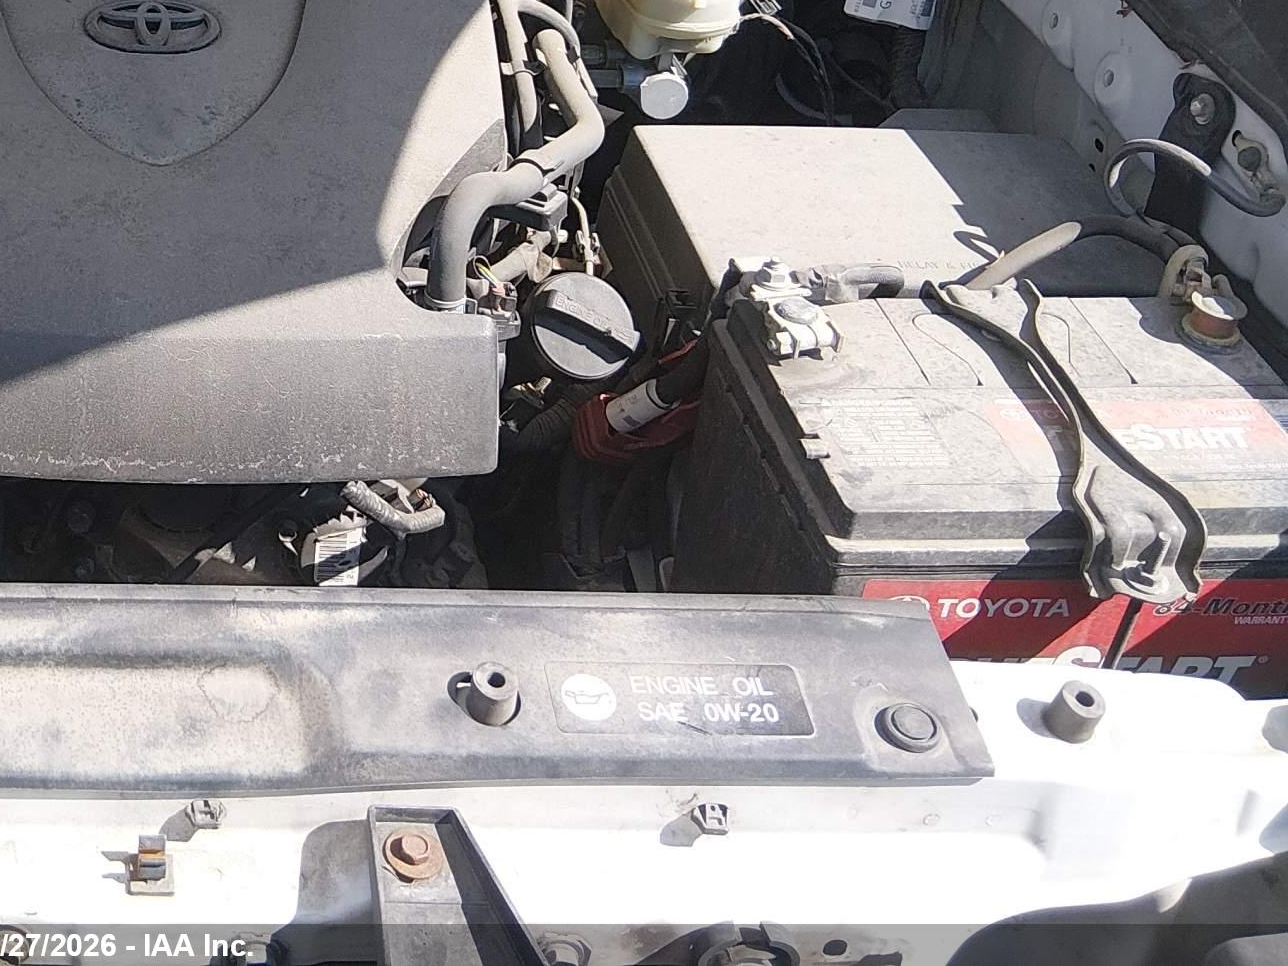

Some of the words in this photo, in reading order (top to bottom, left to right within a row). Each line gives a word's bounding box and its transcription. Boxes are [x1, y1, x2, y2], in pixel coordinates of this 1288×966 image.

[936, 598, 1070, 618] TOYOTA
[630, 675, 719, 697] ENGINE
[732, 676, 774, 697] OIL
[638, 701, 689, 722] SAE
[704, 702, 780, 723] 0W-20
